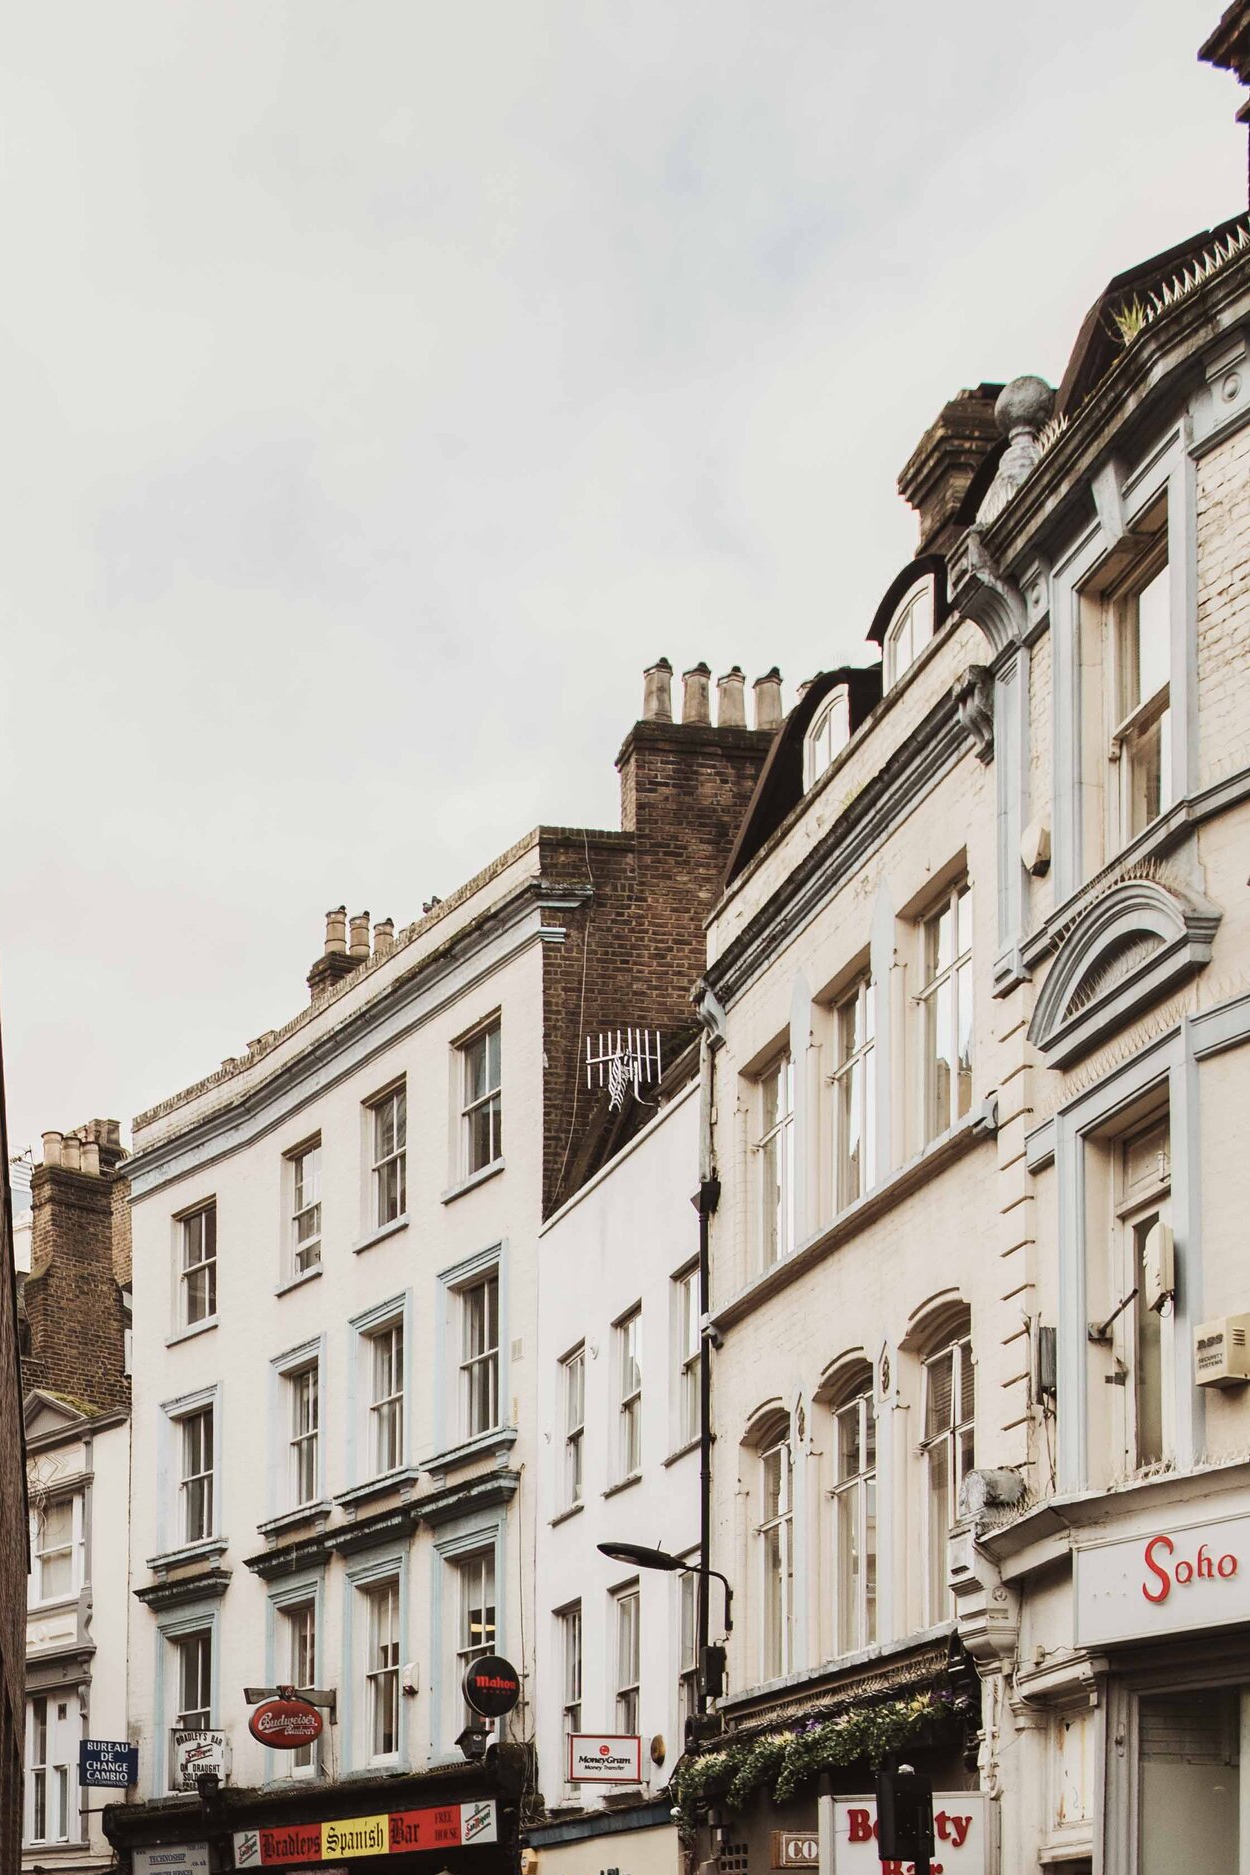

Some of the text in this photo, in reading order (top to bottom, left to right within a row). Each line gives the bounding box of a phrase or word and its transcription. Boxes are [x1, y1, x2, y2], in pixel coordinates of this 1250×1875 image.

[1198, 1352, 1223, 1363] SECURITY
[1142, 1535, 1238, 1603] Soho
[258, 1712, 318, 1731] Budweiser
[284, 1725, 315, 1735] Budvar
[176, 1732, 223, 1746] BRADLEY'S BAR
[87, 1741, 129, 1753] BUREAU
[101, 1752, 114, 1761] DE
[578, 1755, 631, 1765] MoneyGram
[86, 1760, 129, 1772] CHANGE
[180, 1763, 221, 1773] ON DRAUGHT
[87, 1770, 128, 1781] CAMBIO
[434, 1810, 453, 1825] FREE
[262, 1817, 420, 1859] Bradleys Spanish Bar
[434, 1827, 458, 1841] HOUSE
